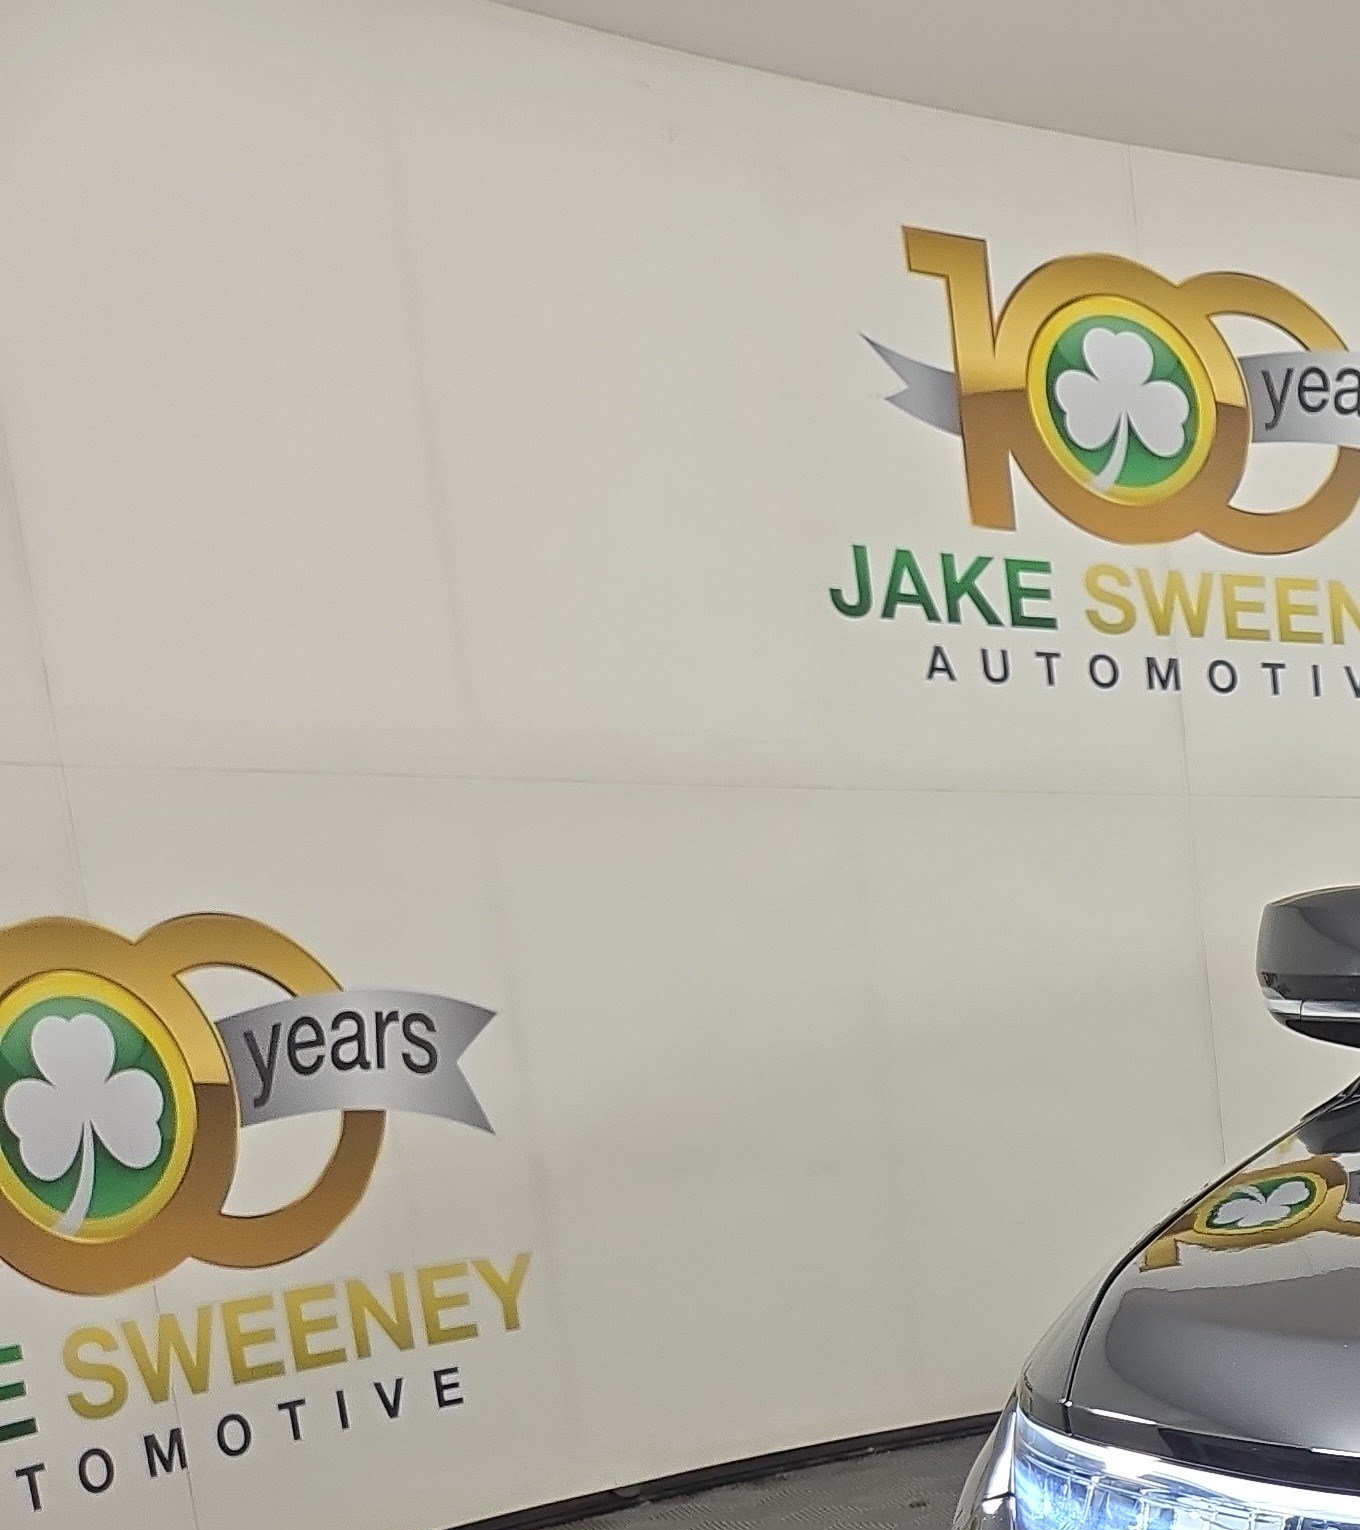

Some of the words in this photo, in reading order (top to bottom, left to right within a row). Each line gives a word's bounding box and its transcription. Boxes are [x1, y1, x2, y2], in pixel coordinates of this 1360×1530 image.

[829, 544, 1058, 631] JAKE
[243, 1008, 440, 1107] years
[61, 1251, 533, 1422] SWEENEY
[15, 1366, 466, 1512] TOMOTIVE
